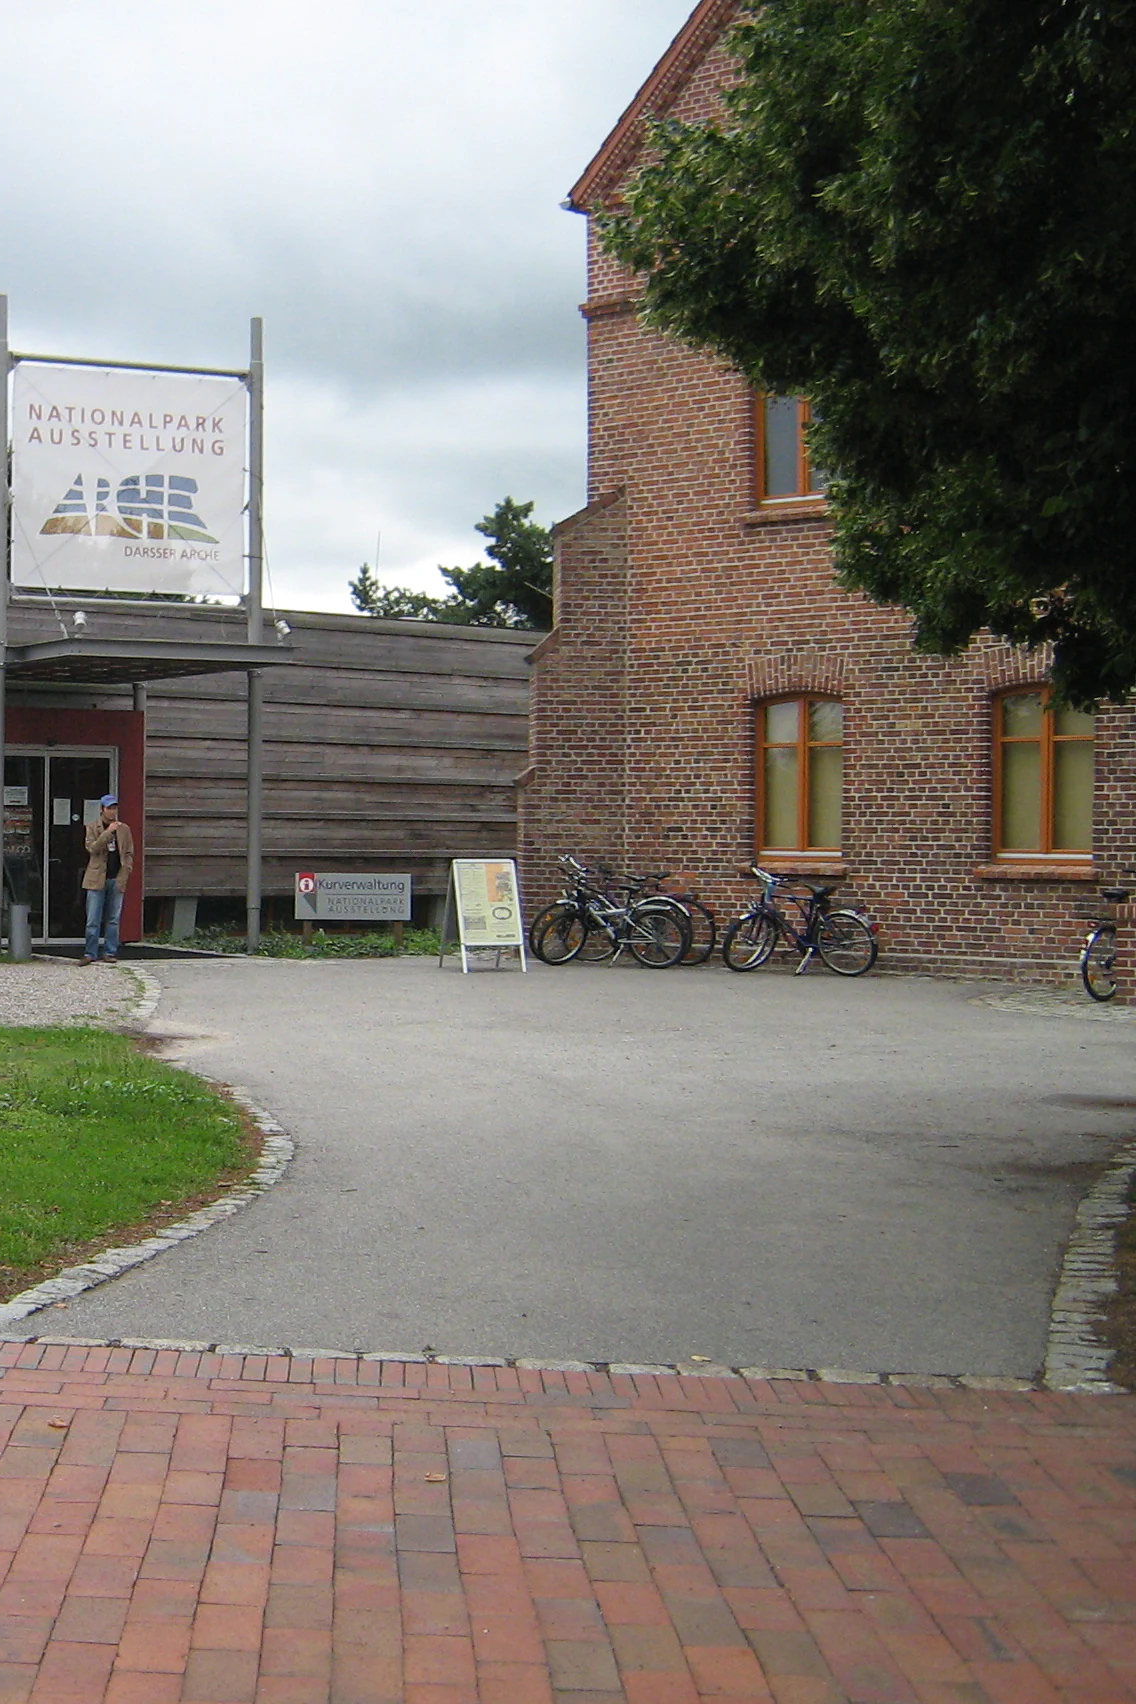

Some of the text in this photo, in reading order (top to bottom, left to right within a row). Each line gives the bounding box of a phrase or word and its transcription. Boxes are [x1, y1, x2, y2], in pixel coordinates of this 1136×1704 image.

[29, 403, 224, 434] NATIONALPARK
[28, 426, 225, 457] AUSSTELLUNG
[124, 546, 221, 562] DARSSER ARCHE
[318, 879, 405, 893] Kurverwaltung
[327, 898, 405, 906] NATIONALPARK
[328, 906, 405, 914] AUSSTELLUNG
